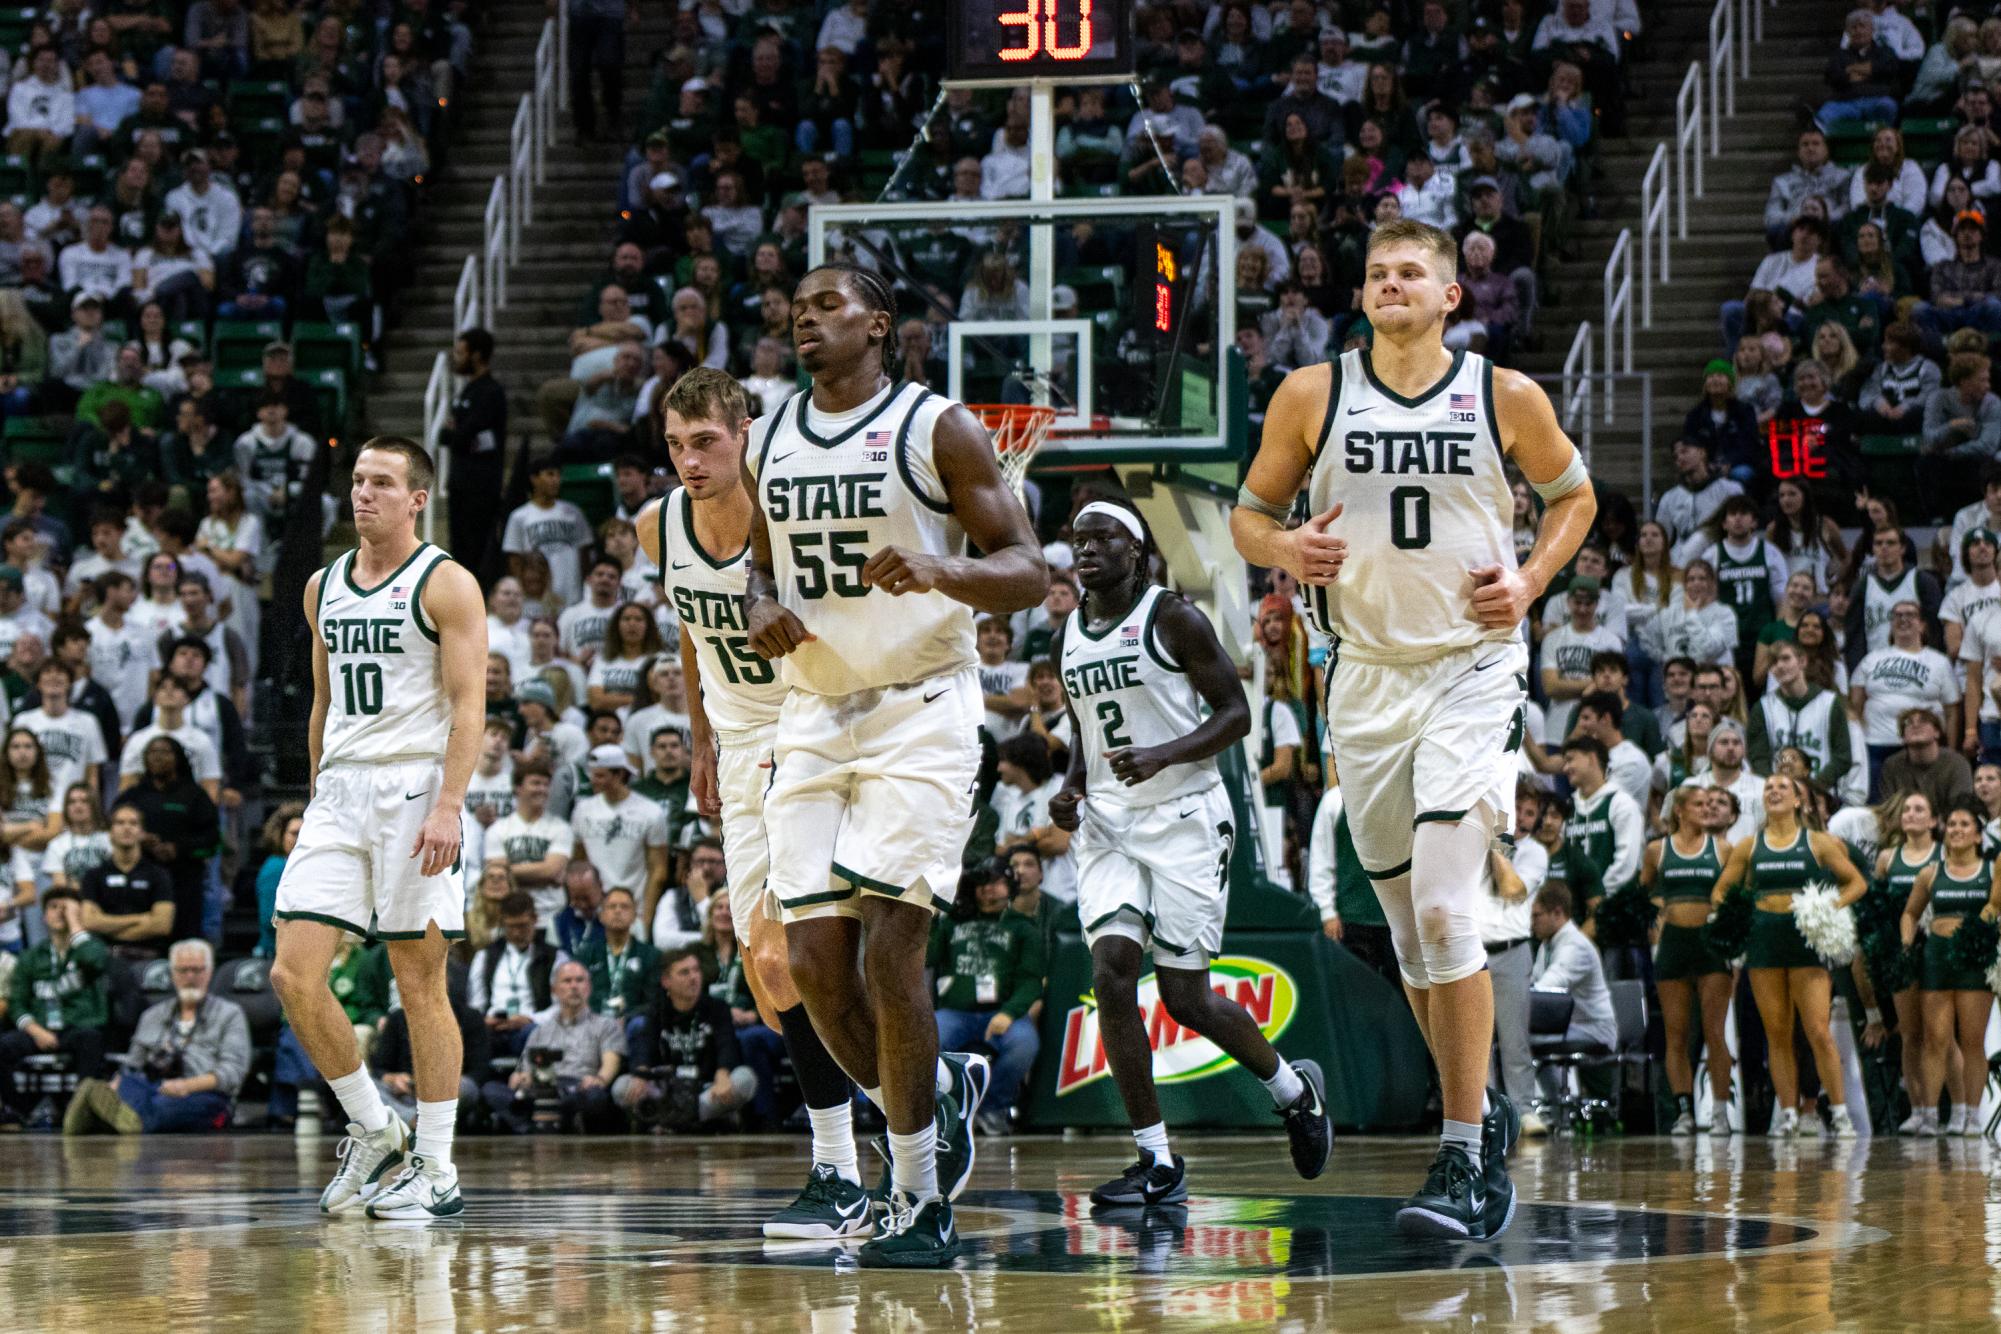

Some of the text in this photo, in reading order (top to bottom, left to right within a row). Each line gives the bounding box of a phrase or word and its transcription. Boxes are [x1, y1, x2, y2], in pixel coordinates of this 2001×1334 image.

[1345, 430, 1477, 476] STATE
[767, 472, 888, 523] STATE
[1390, 485, 1432, 550] 0
[788, 530, 874, 600] 55
[672, 586, 749, 631] STAT
[323, 618, 405, 654] STATE
[704, 635, 776, 685] 15
[340, 662, 384, 716] 10
[1064, 654, 1145, 699] STATE
[1096, 700, 1133, 749] 2
